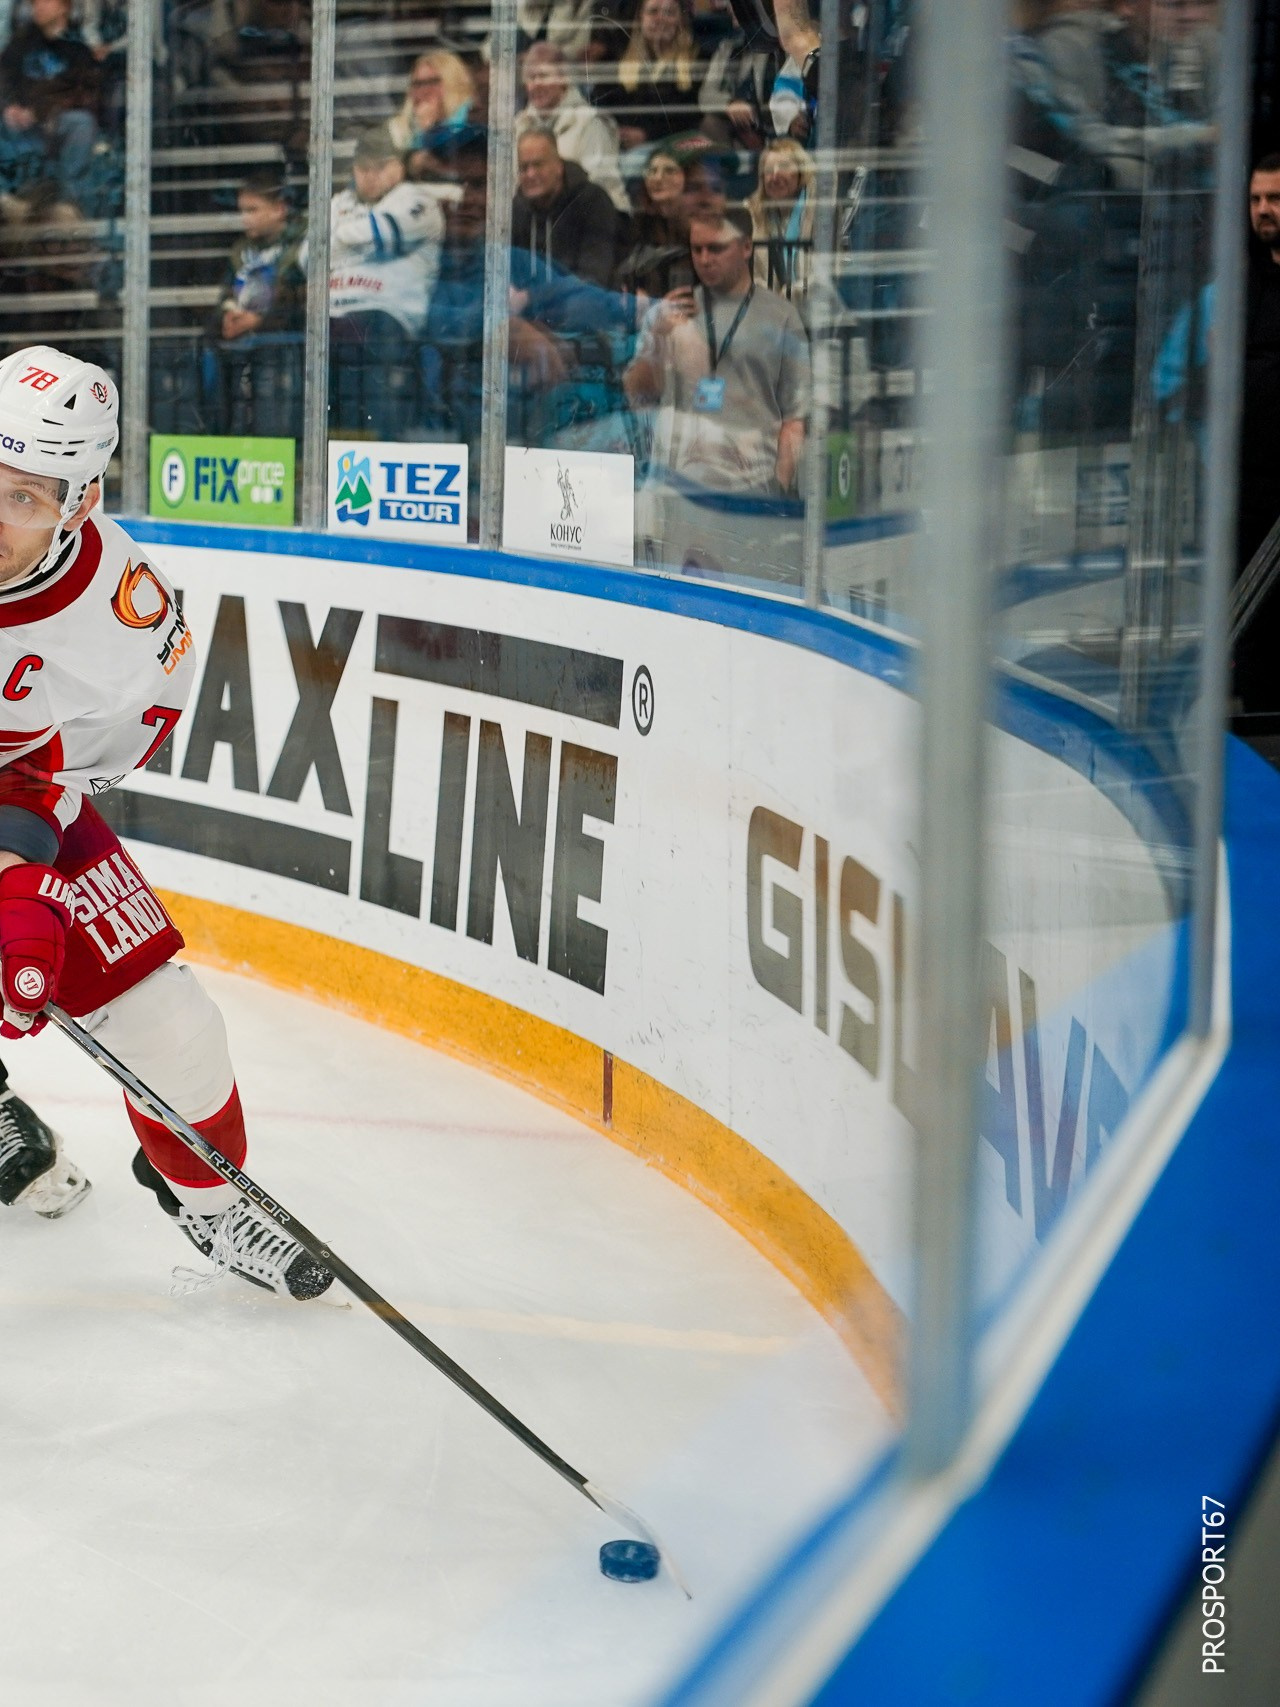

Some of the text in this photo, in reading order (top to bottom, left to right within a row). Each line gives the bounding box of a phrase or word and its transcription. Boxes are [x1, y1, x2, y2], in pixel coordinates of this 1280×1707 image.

[19, 366, 60, 392] 78
[379, 461, 461, 498] TEZ
[384, 501, 454, 523] TOUR
[2, 654, 44, 701] C
[145, 588, 365, 818] AX
[359, 696, 619, 997] LINE
[73, 852, 143, 924] SIMA
[84, 888, 169, 965] LAND
[208, 1150, 291, 1224] RIBCOR
